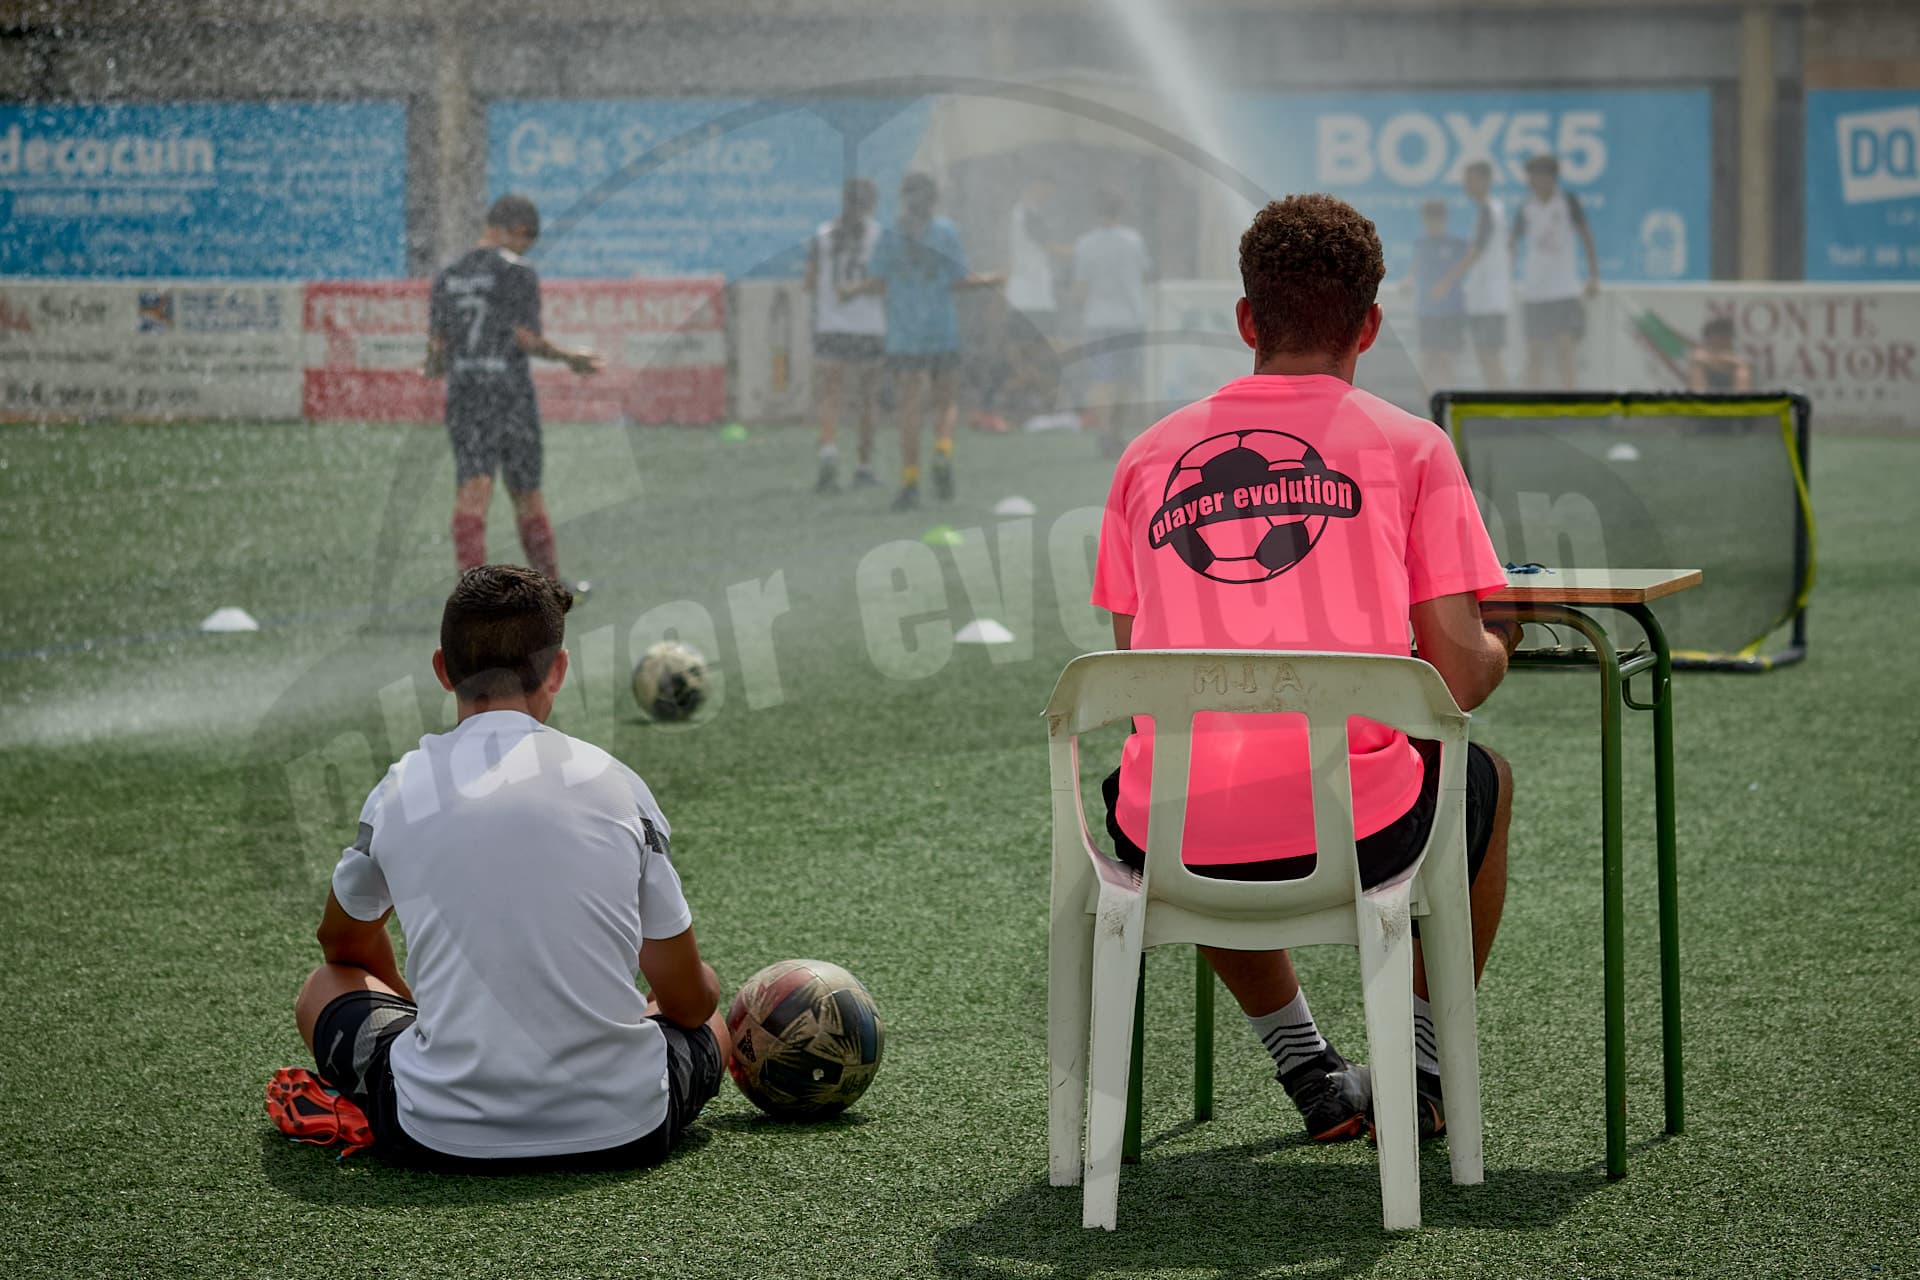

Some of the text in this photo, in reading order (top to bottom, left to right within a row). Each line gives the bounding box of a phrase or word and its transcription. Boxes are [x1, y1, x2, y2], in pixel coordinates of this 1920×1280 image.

[1316, 111, 1608, 187] BOX55
[456, 295, 487, 353] 7
[1152, 475, 1353, 545] player evolution
